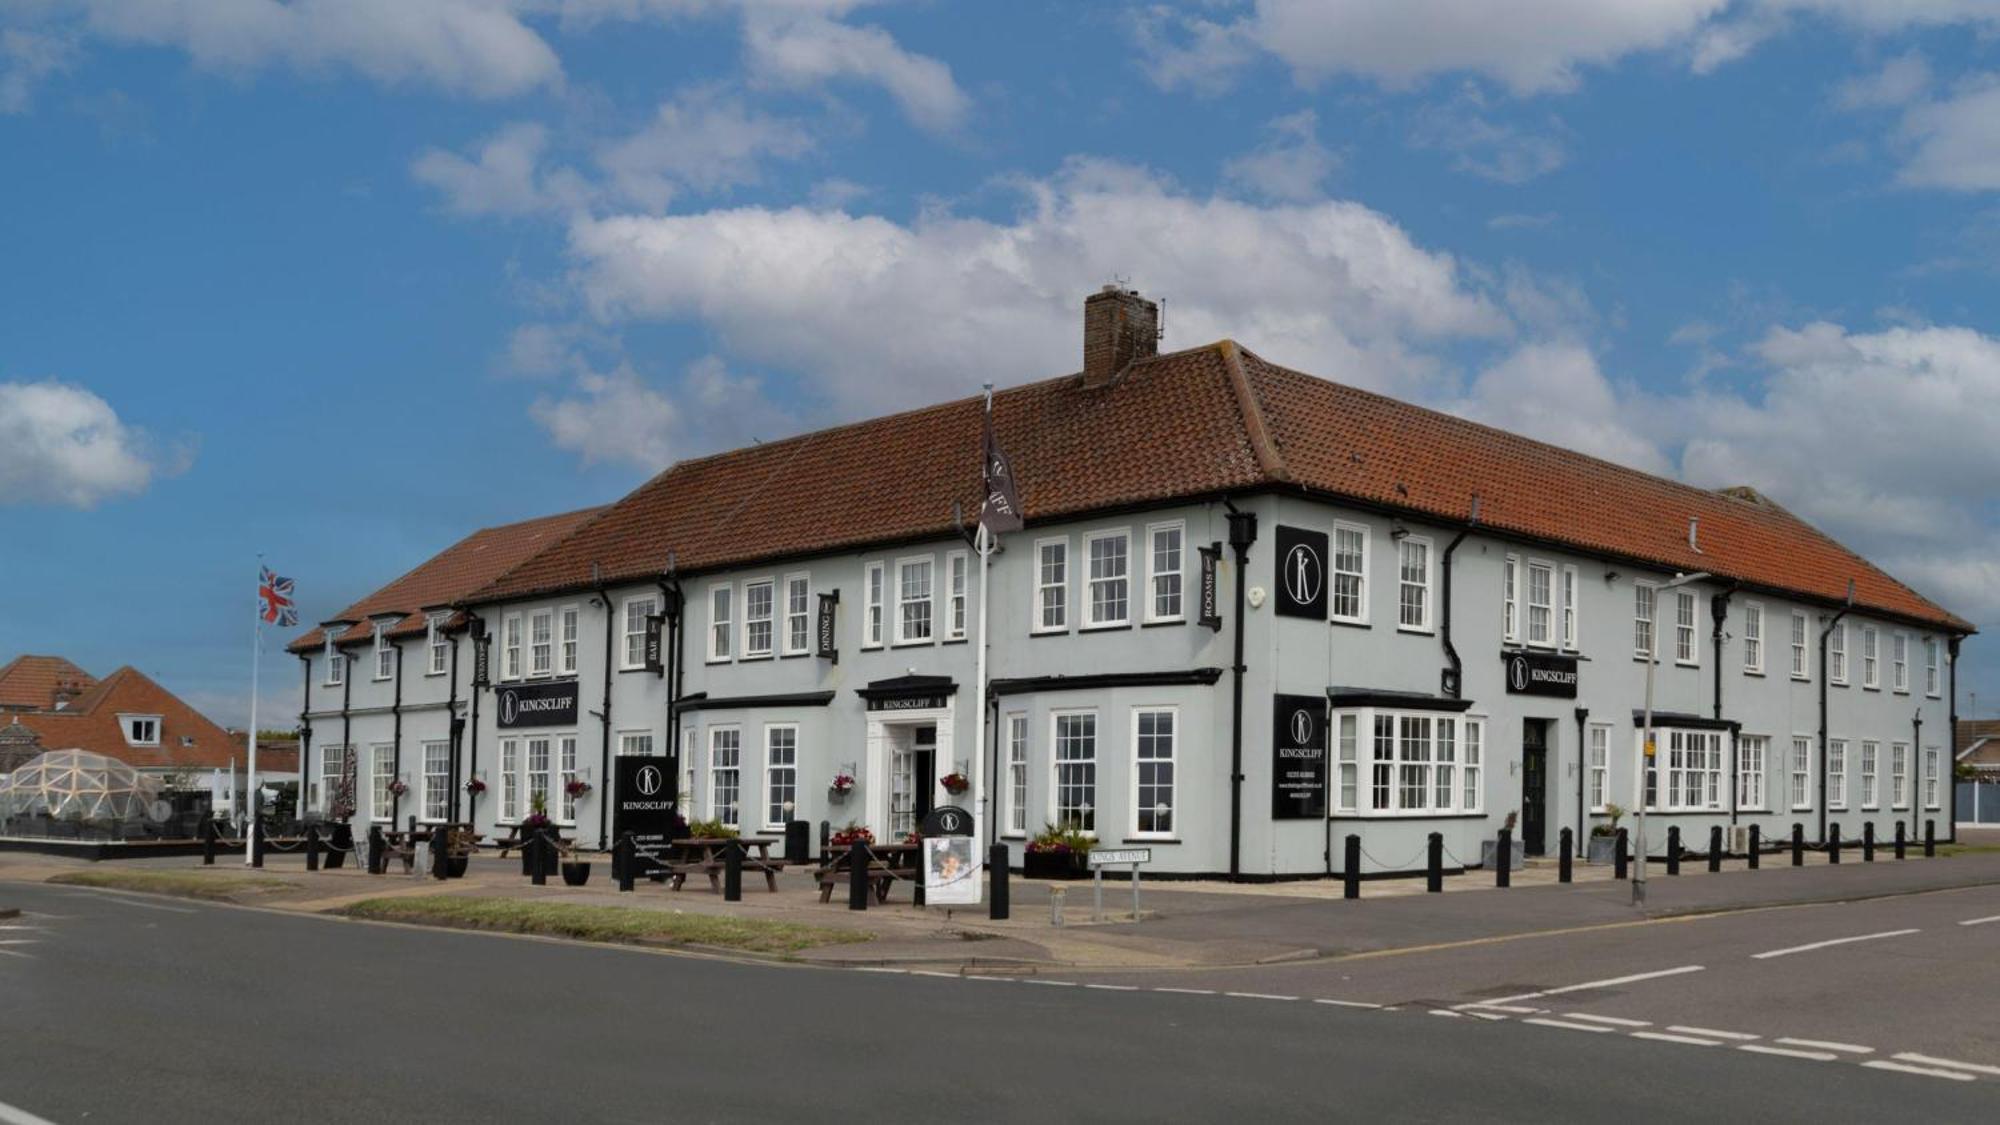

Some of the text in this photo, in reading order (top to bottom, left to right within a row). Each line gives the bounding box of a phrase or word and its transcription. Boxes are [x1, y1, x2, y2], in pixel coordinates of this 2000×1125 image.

[1205, 573, 1213, 617] ROOMS
[822, 615, 830, 650] DINING
[1531, 668, 1577, 684] KINGSCLIFF
[519, 697, 573, 712] KINGSCLIFF
[883, 698, 930, 710] KINGSCLIFF
[1279, 748, 1322, 758] KINGSCLIFF
[623, 801, 673, 810] KINGSCLIFF
[1119, 851, 1147, 861] AVENUE
